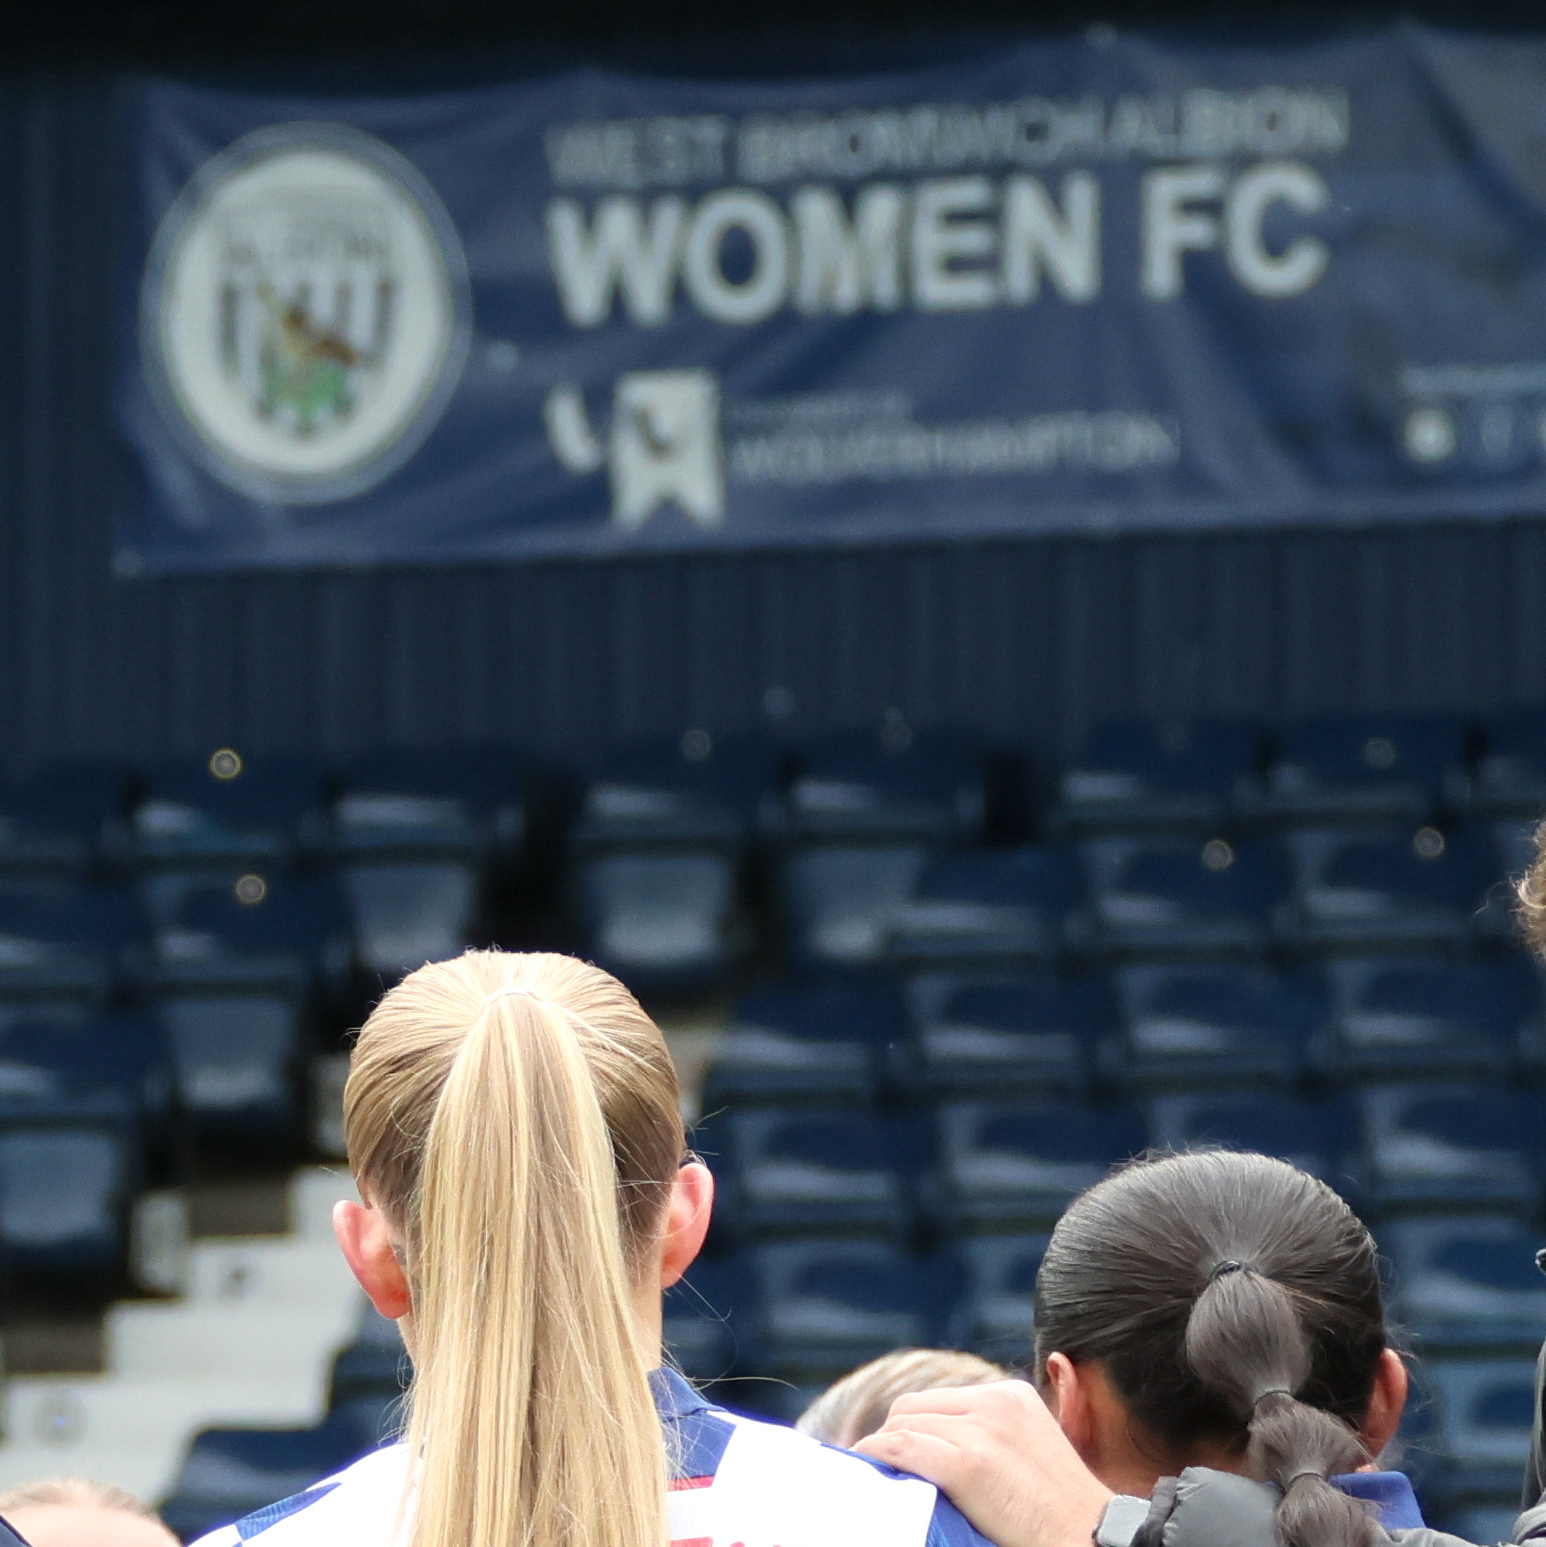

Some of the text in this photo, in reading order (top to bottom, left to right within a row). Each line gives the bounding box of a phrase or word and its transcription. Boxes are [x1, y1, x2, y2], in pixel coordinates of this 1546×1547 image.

[544, 84, 1350, 187] WEST BROMWICH ALBION
[549, 160, 1334, 328] WOMEN FC
